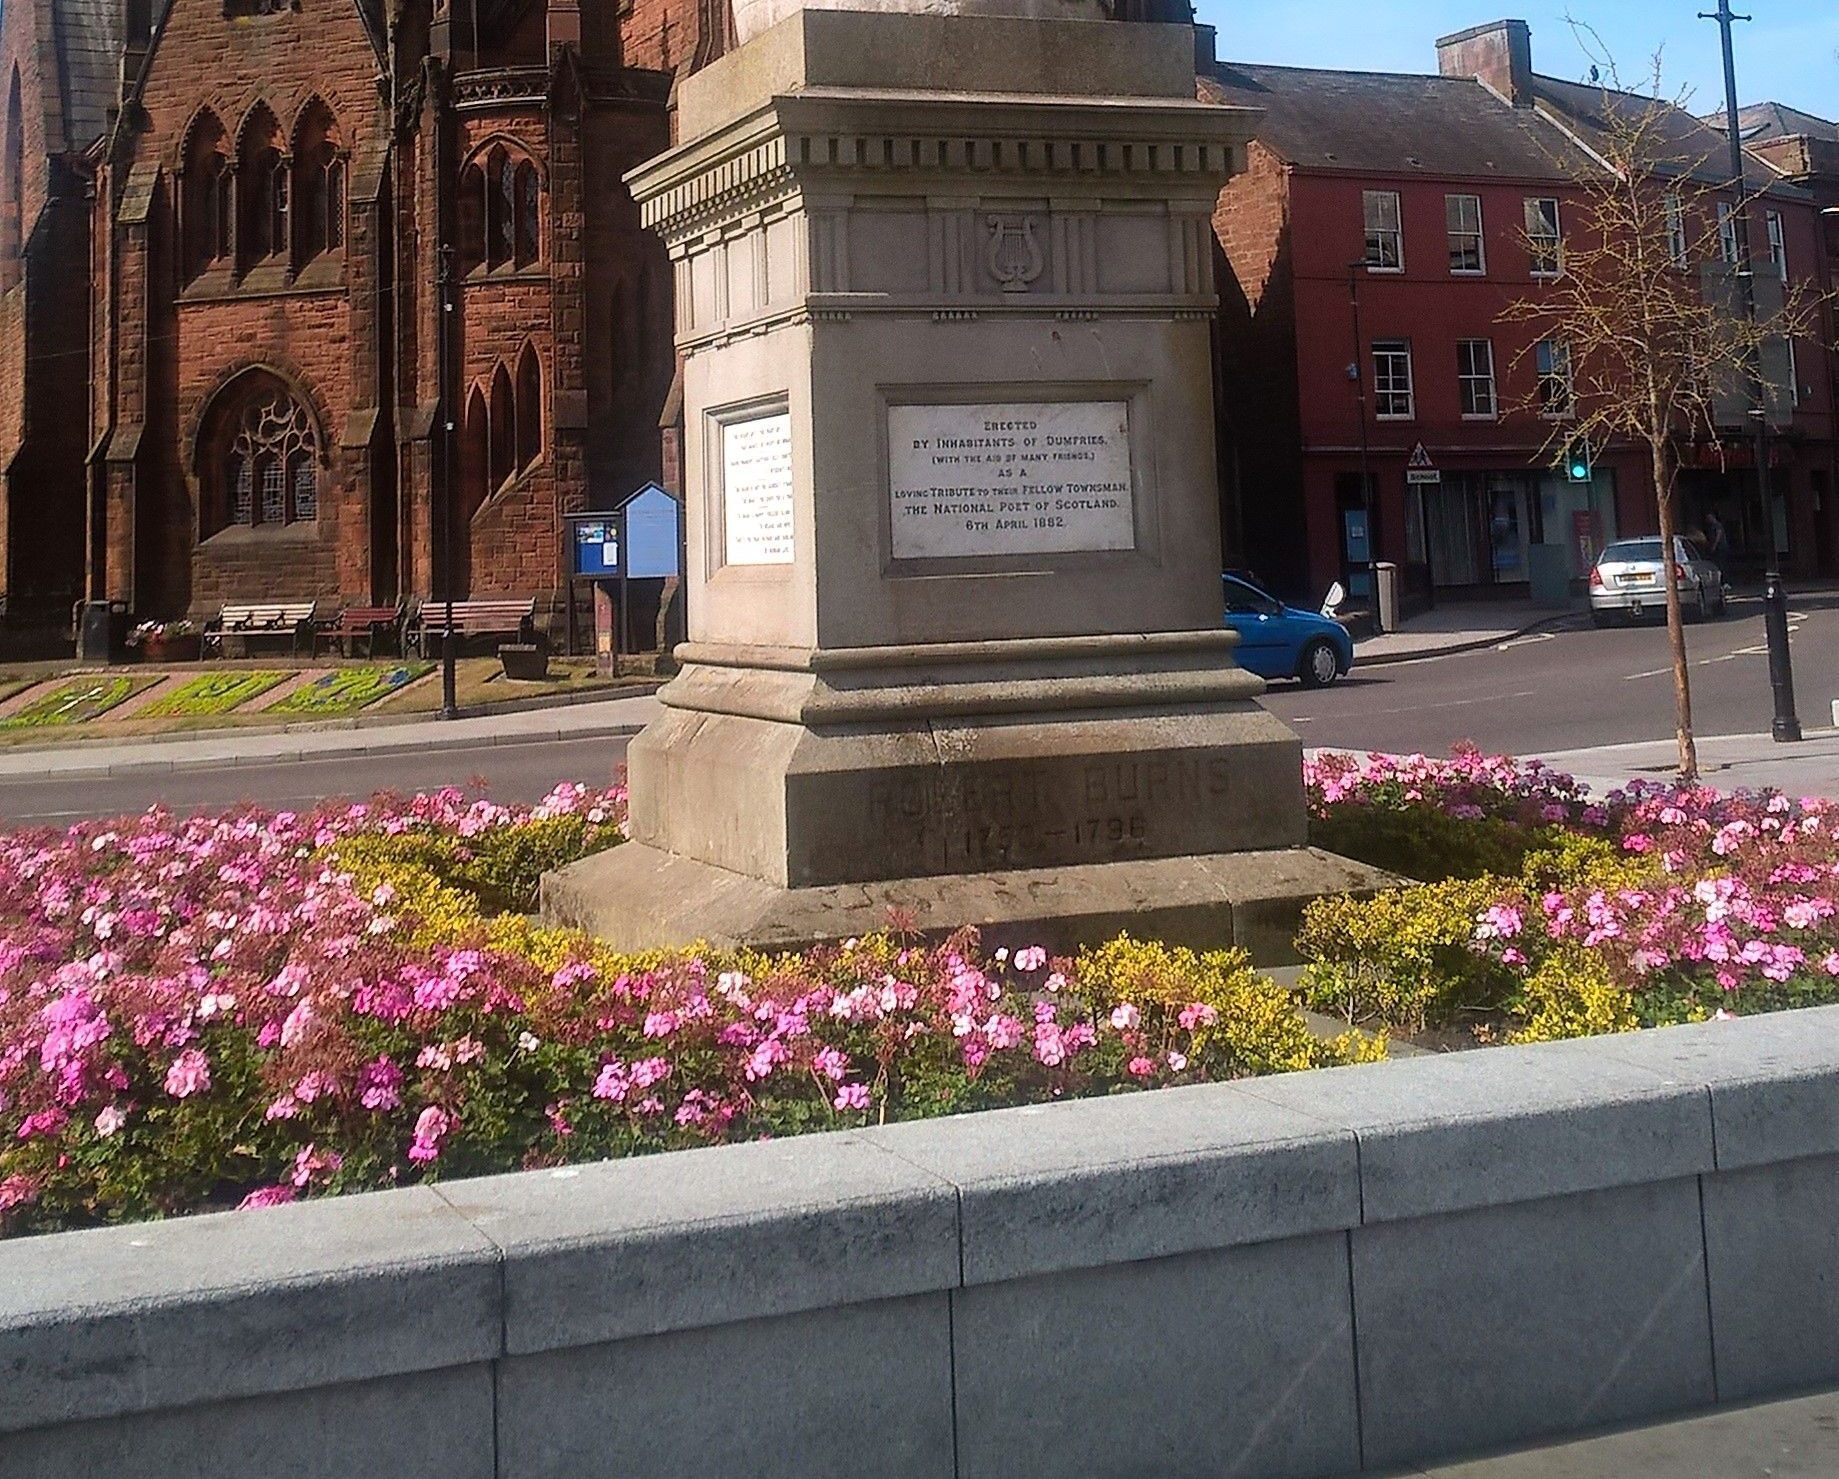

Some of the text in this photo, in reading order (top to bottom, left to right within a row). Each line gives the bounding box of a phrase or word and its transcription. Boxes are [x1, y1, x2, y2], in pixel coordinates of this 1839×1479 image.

[913, 440, 929, 449] BY
[937, 438, 1015, 449] INHABITANTS
[1024, 438, 1038, 446] OF
[1021, 454, 1048, 462] MANY
[998, 469, 1027, 478] AS A
[930, 487, 975, 498] TRIBUTE
[978, 488, 989, 496] TO
[1022, 484, 1063, 495] FELLOW
[934, 503, 993, 514] NATIONAL
[1000, 501, 1030, 512] POET
[1036, 502, 1050, 510] OF
[966, 521, 989, 531] 6TH
[995, 519, 1028, 529] APRIL
[1084, 757, 1230, 802] BURNS
